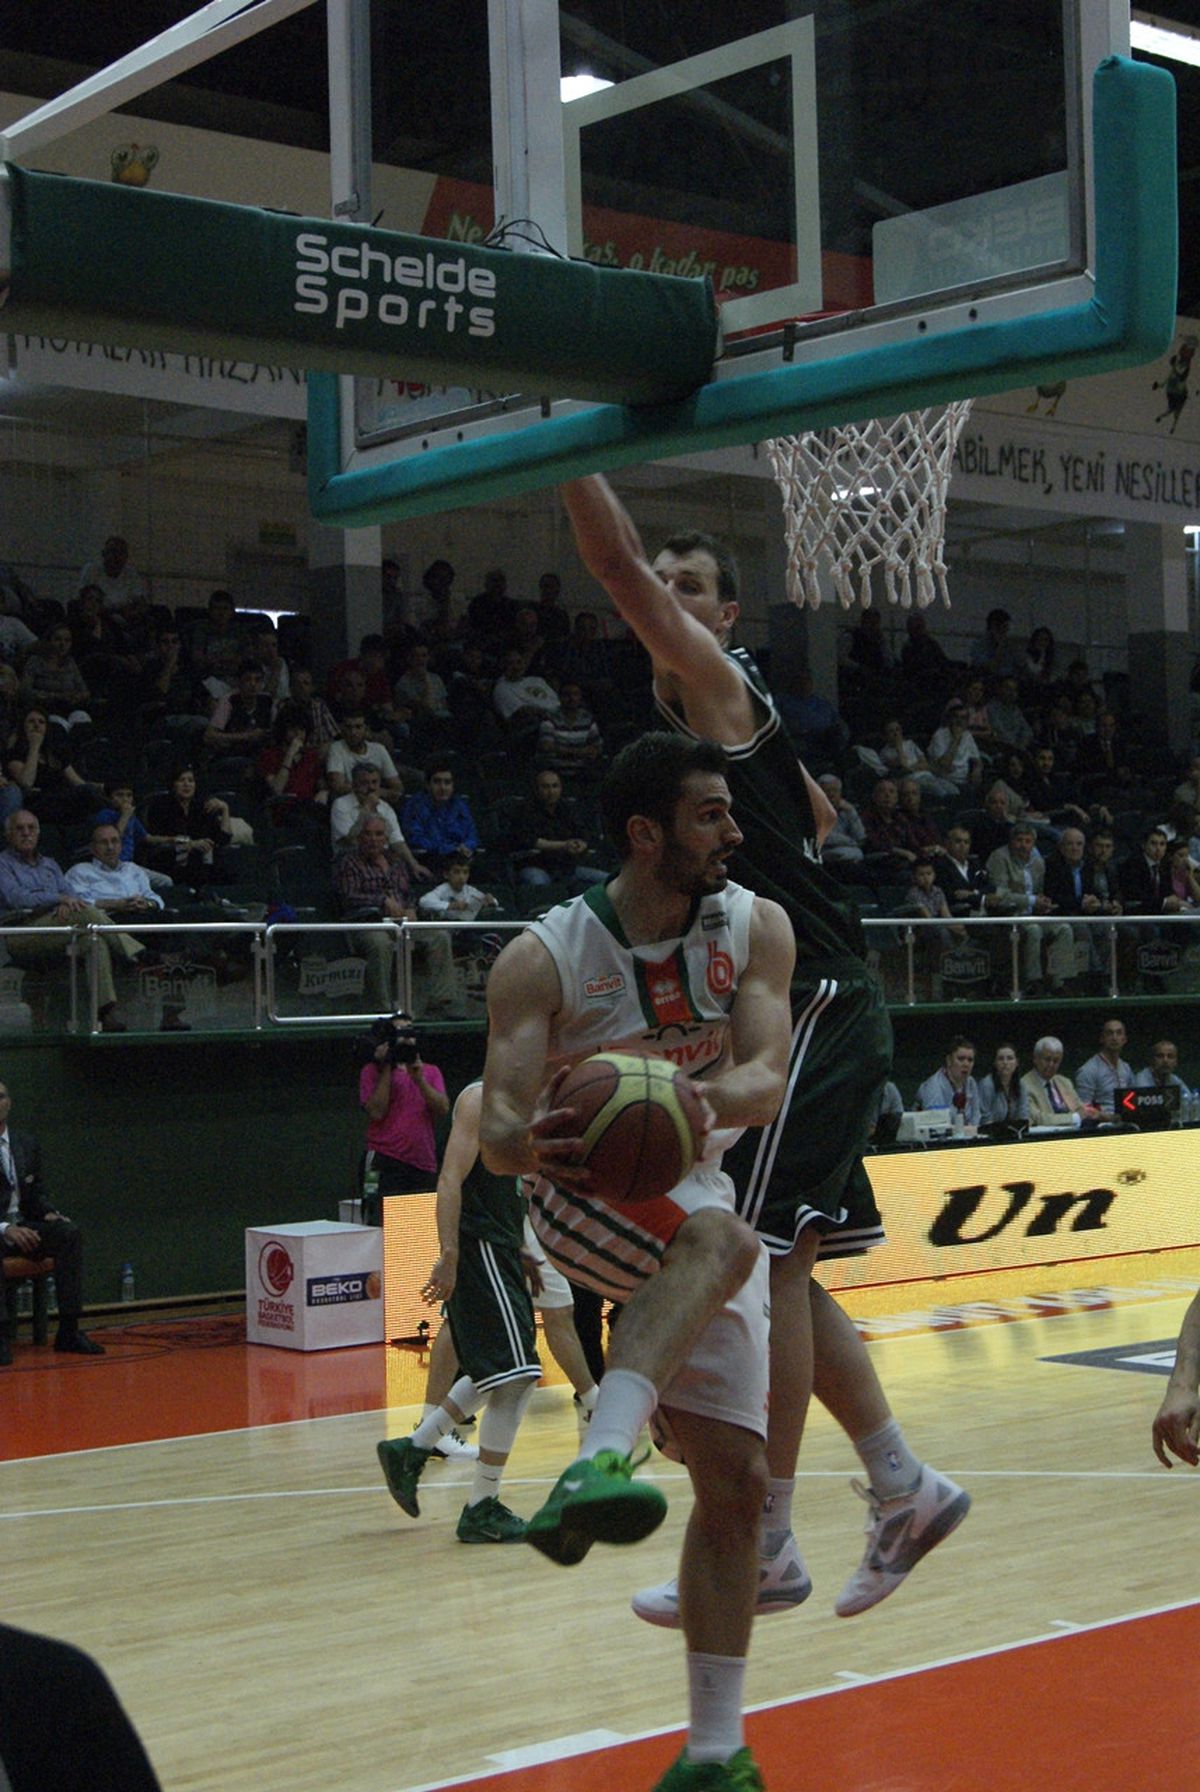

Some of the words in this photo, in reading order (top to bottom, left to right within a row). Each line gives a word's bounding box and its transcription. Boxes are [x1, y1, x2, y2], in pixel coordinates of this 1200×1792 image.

[296, 233, 496, 298] Schelde
[719, 265, 761, 291] pas
[294, 274, 495, 337] Sports
[586, 977, 623, 995] Banvit
[1137, 1094, 1164, 1107] POSS
[312, 1280, 362, 1297] BEKO
